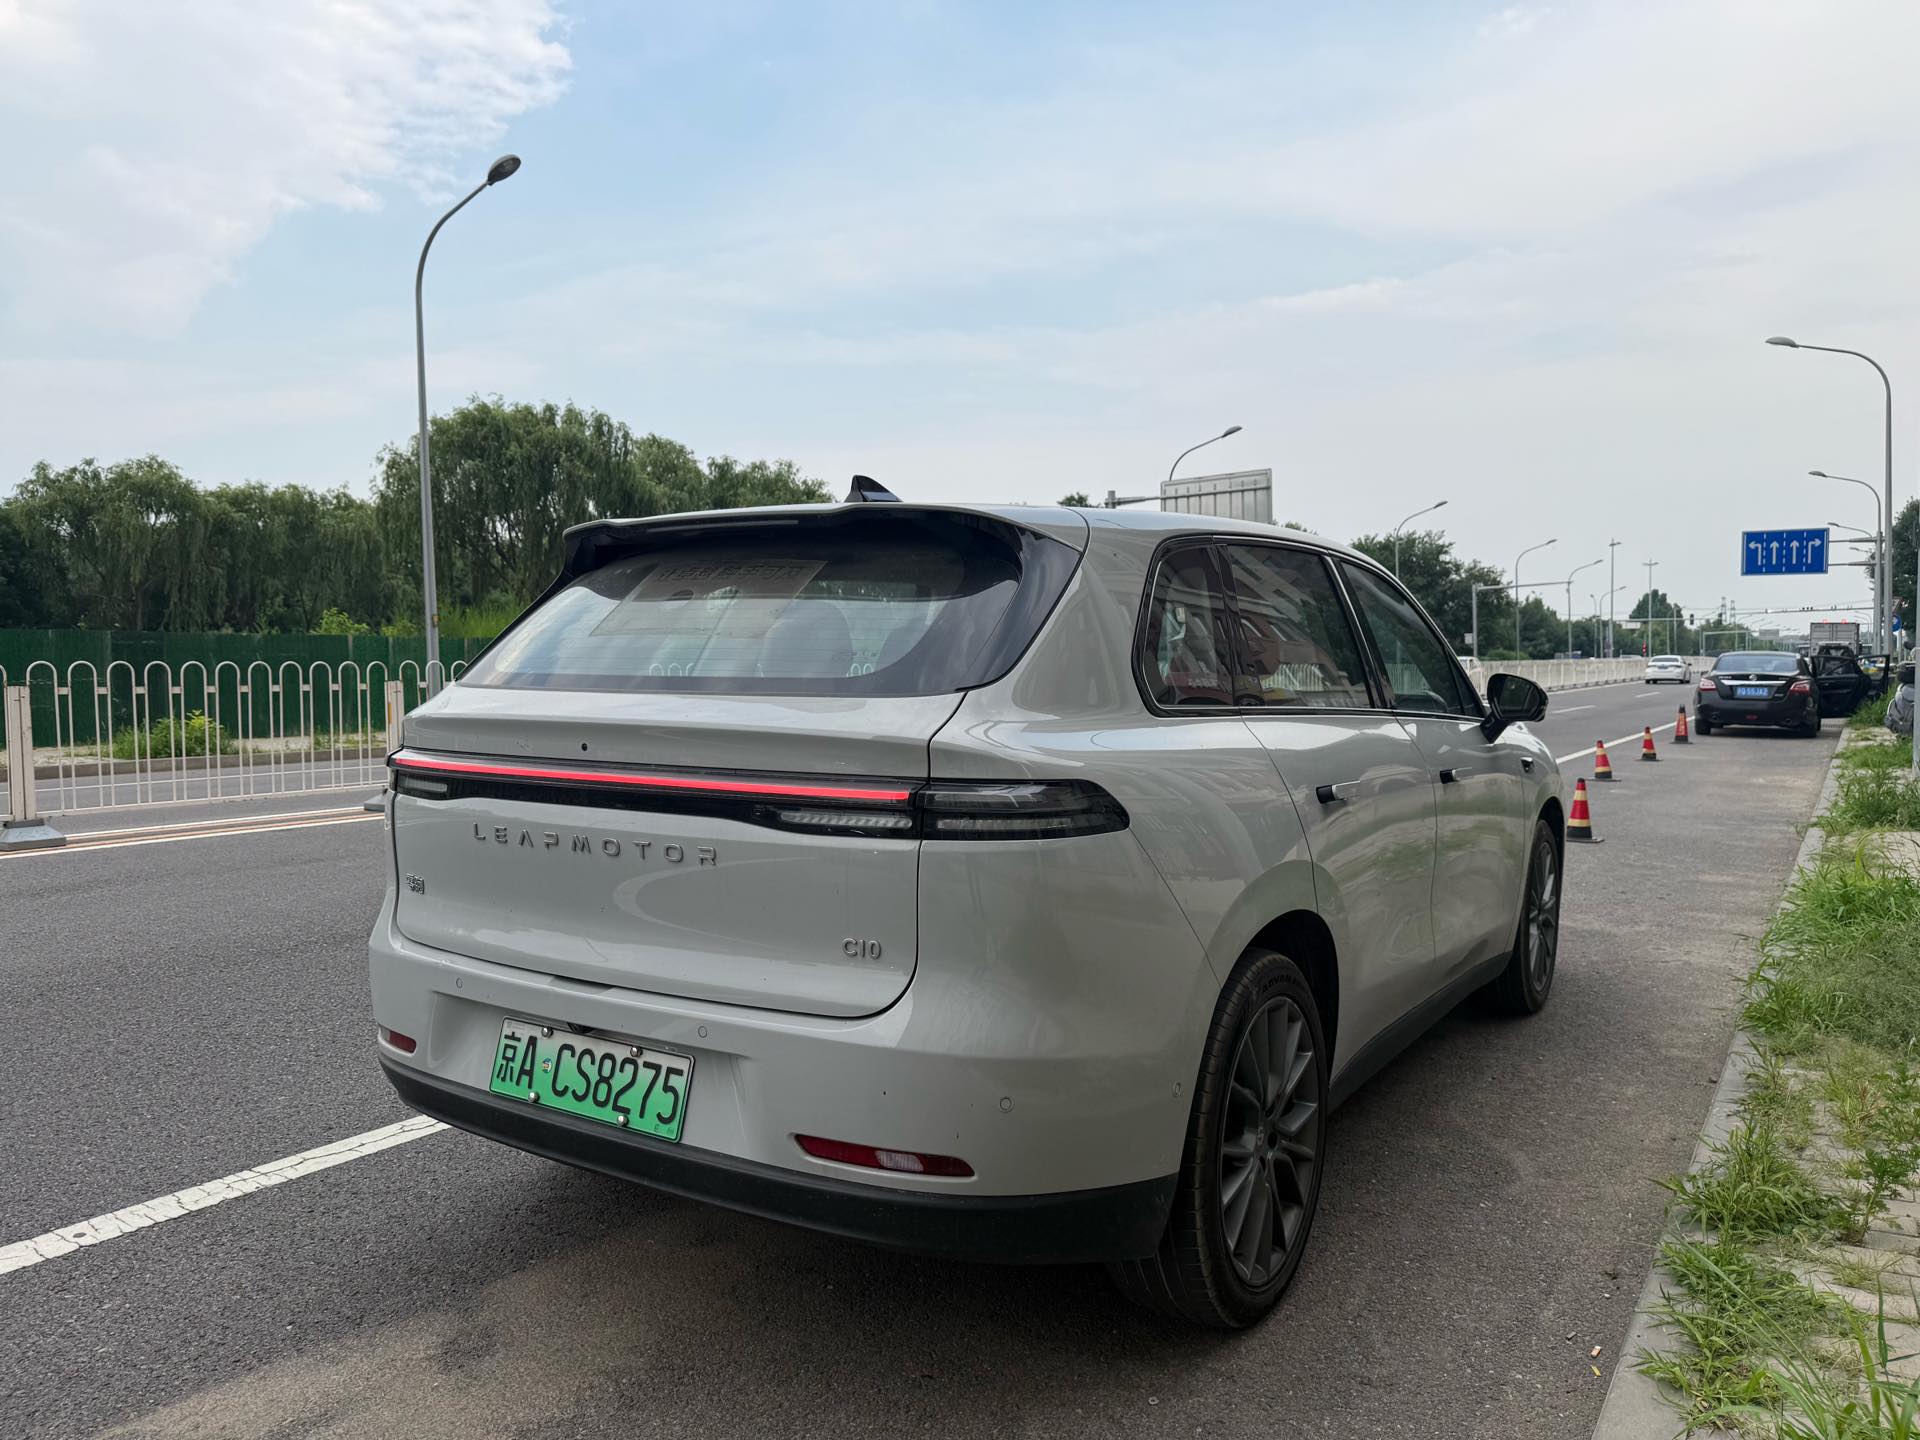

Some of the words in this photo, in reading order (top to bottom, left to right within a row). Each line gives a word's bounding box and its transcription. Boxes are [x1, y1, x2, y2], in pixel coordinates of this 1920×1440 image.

[473, 822, 719, 867] LEAPMOTOR
[841, 936, 884, 962] C10
[551, 1043, 685, 1125] CS8275
